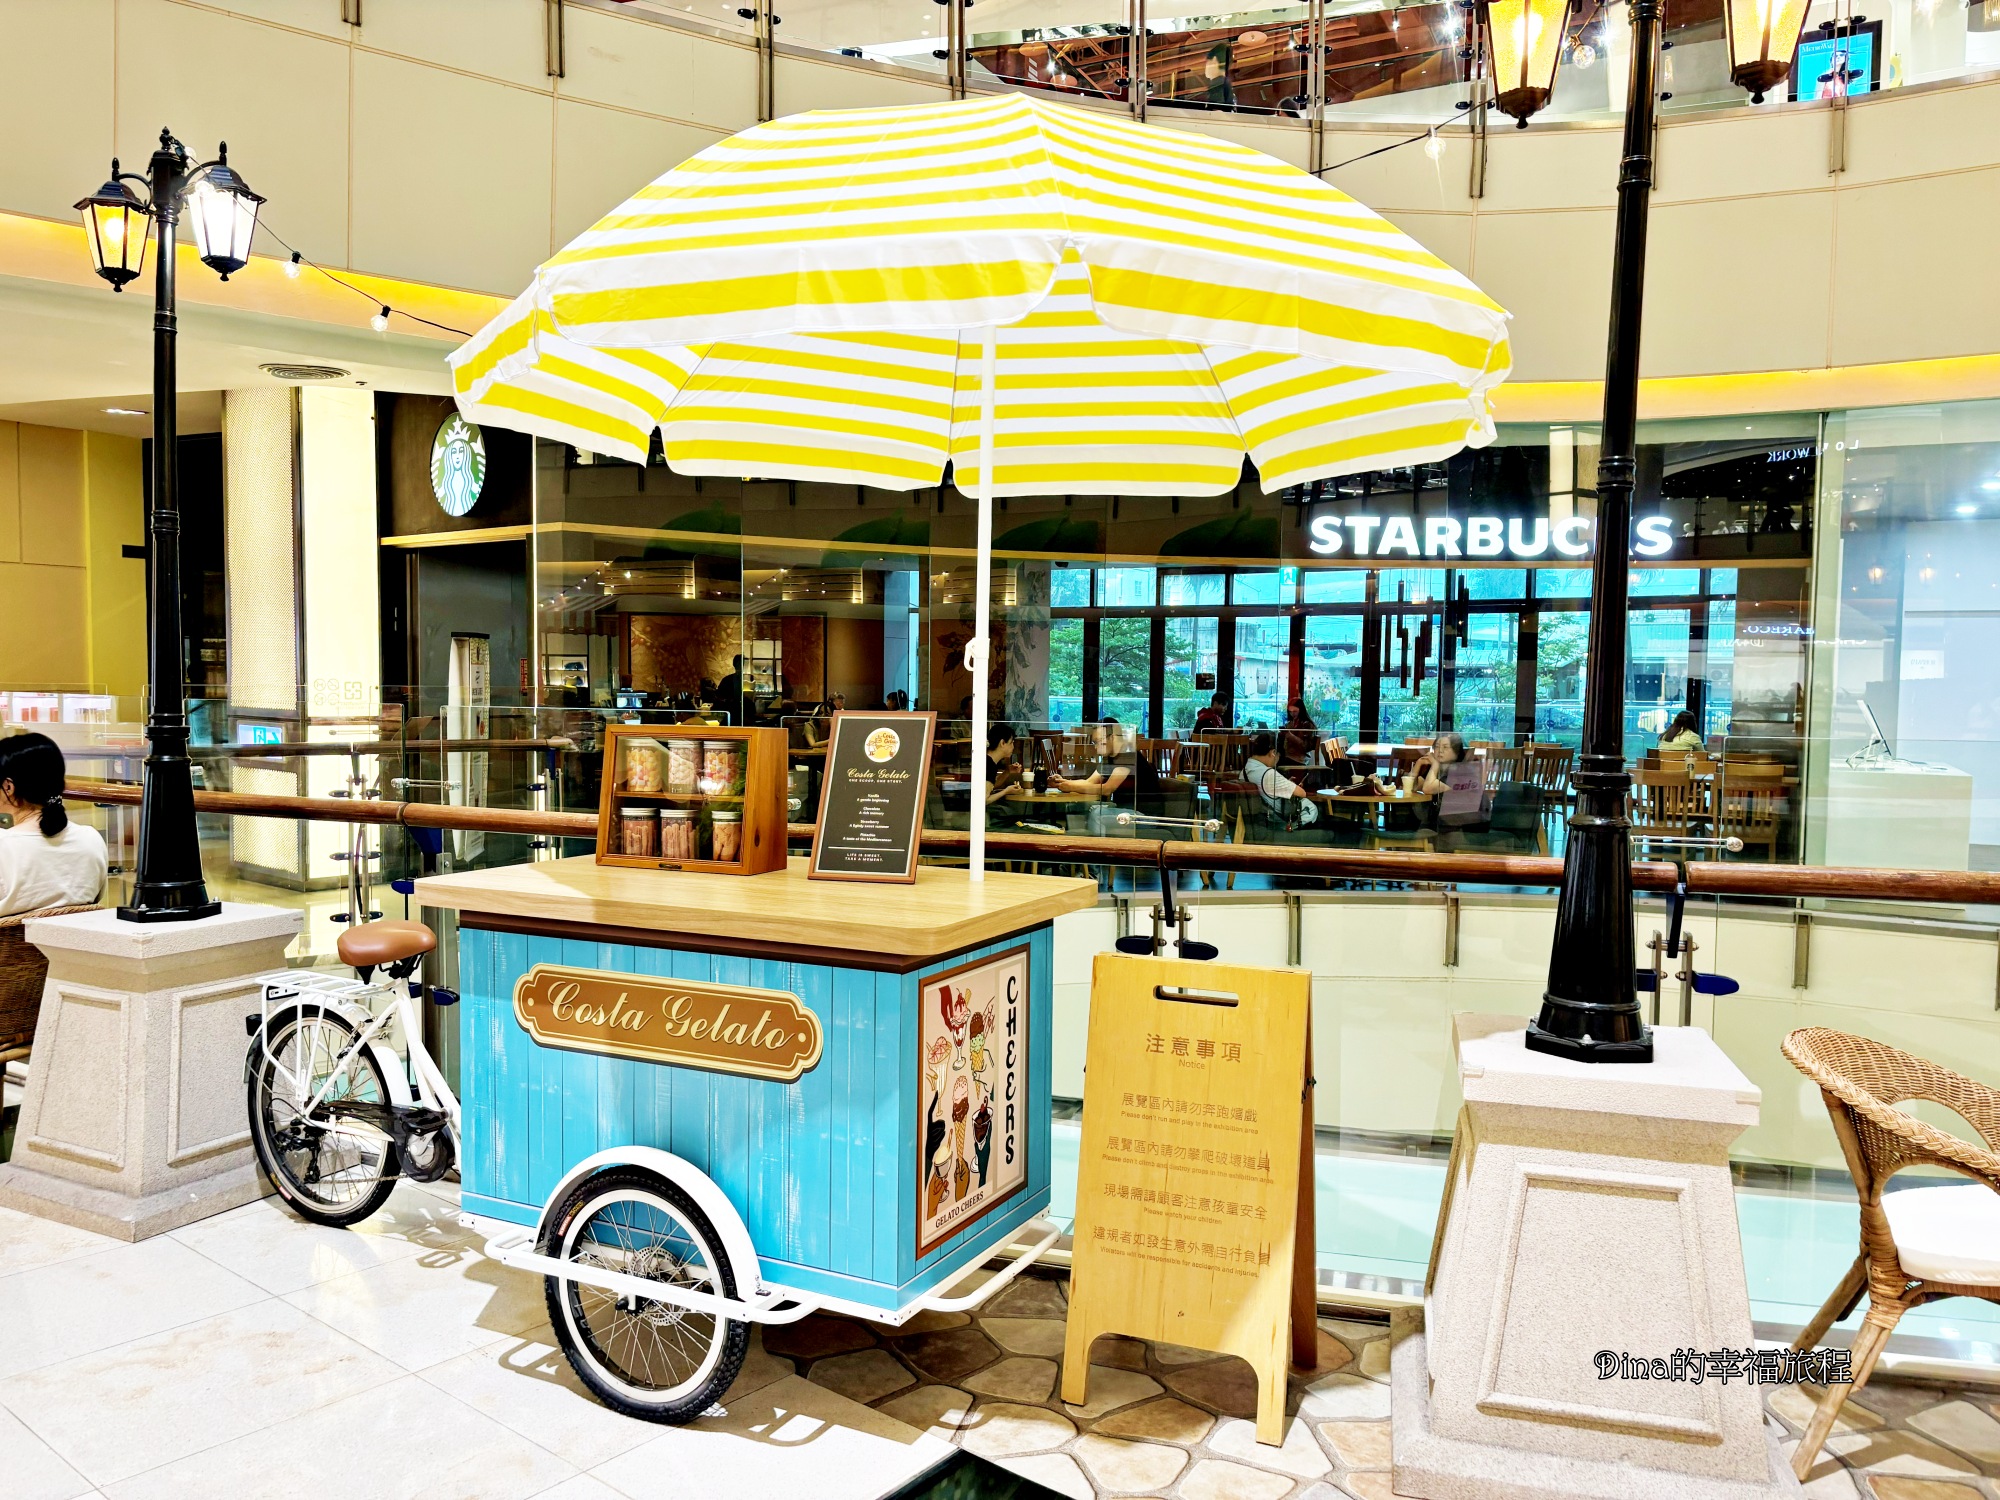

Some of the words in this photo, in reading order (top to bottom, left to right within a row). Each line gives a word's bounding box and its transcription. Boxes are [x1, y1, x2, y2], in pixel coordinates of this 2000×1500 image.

[1309, 516, 1673, 557] STARBUCS
[847, 768, 876, 778] Costa
[878, 768, 910, 780] Gelato
[547, 981, 653, 1032] Costa
[662, 995, 795, 1050] Gelato
[1145, 1033, 1242, 1063] 注意事項
[1005, 975, 1019, 1166] CHEERS
[1178, 1059, 1205, 1070] Notice
[1121, 1092, 1258, 1123] 展覽區內請勿奔跑嬉戲
[1121, 1110, 1140, 1119] Please
[1142, 1113, 1156, 1121] don't
[1182, 1119, 1194, 1127] play
[1214, 1123, 1243, 1133] exhibition
[1102, 1154, 1122, 1162] Please
[1139, 1158, 1155, 1167] climb
[1192, 1167, 1208, 1176] props
[1216, 1169, 1227, 1177] the
[1228, 1170, 1258, 1182] exhibition
[1106, 1135, 1271, 1173] 展覽區內請勿攀爬破壞道具
[935, 1206, 960, 1229] GELATO
[960, 1190, 984, 1218] CHEERS
[1104, 1183, 1268, 1221] 現場需請顧客注意孩童安全
[1144, 1207, 1163, 1216] Please
[1165, 1210, 1182, 1219] watch
[1183, 1214, 1197, 1222] your
[1198, 1214, 1222, 1224] children
[1100, 1246, 1126, 1256] Violators
[1146, 1254, 1181, 1265] responsible
[1192, 1261, 1221, 1272] accidents
[1235, 1268, 1259, 1278] injuries.
